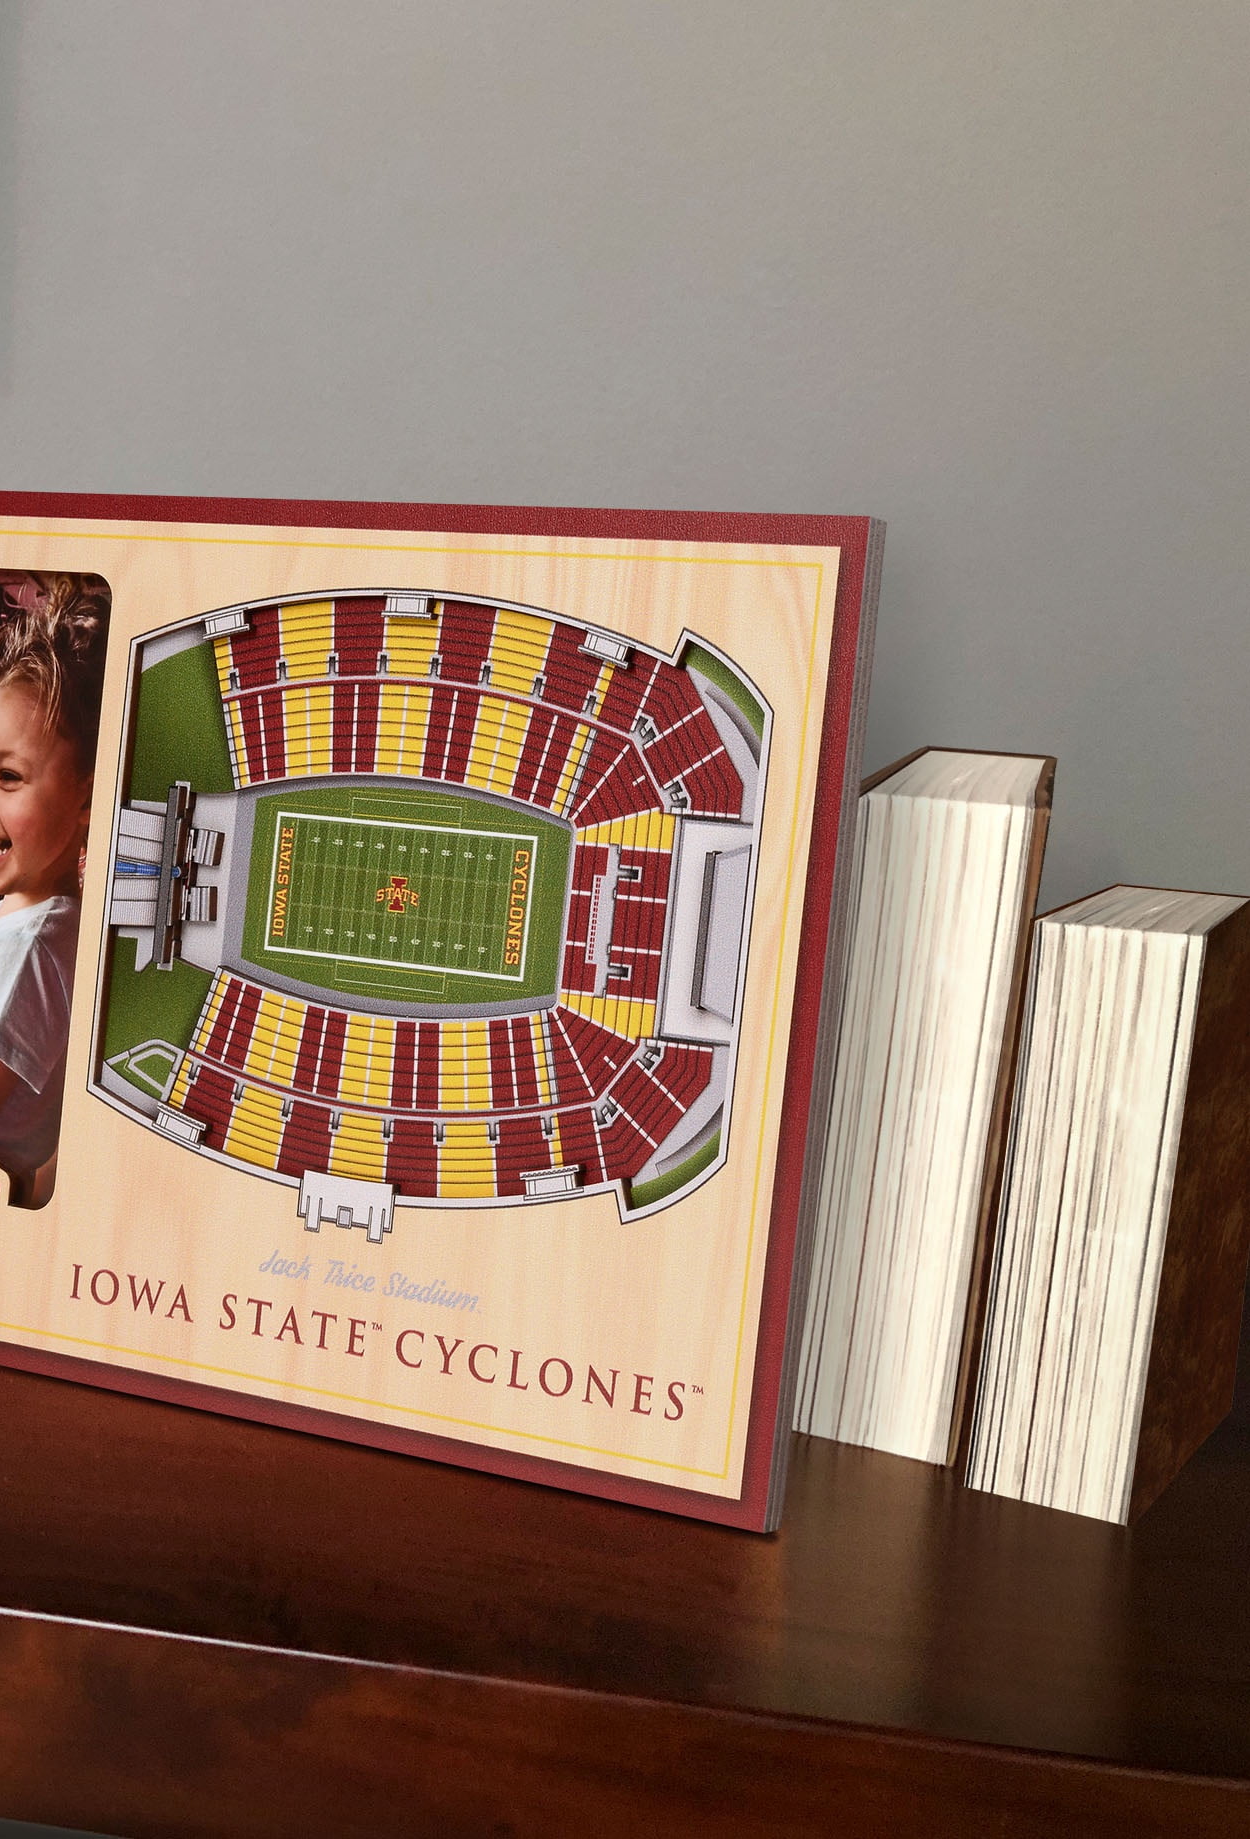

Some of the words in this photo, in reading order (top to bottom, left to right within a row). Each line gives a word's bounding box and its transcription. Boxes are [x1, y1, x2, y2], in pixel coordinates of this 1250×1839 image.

[277, 826, 294, 885] STATE
[271, 887, 288, 937] IOWA
[375, 886, 420, 907] STATE
[504, 849, 530, 966] CYCLONES
[258, 1249, 313, 1281] Jack
[323, 1258, 376, 1293] Trice
[381, 1271, 479, 1313] Stadium
[69, 1263, 194, 1323] IOWA
[219, 1293, 367, 1358] STATE
[395, 1329, 686, 1422] CYCLONES
